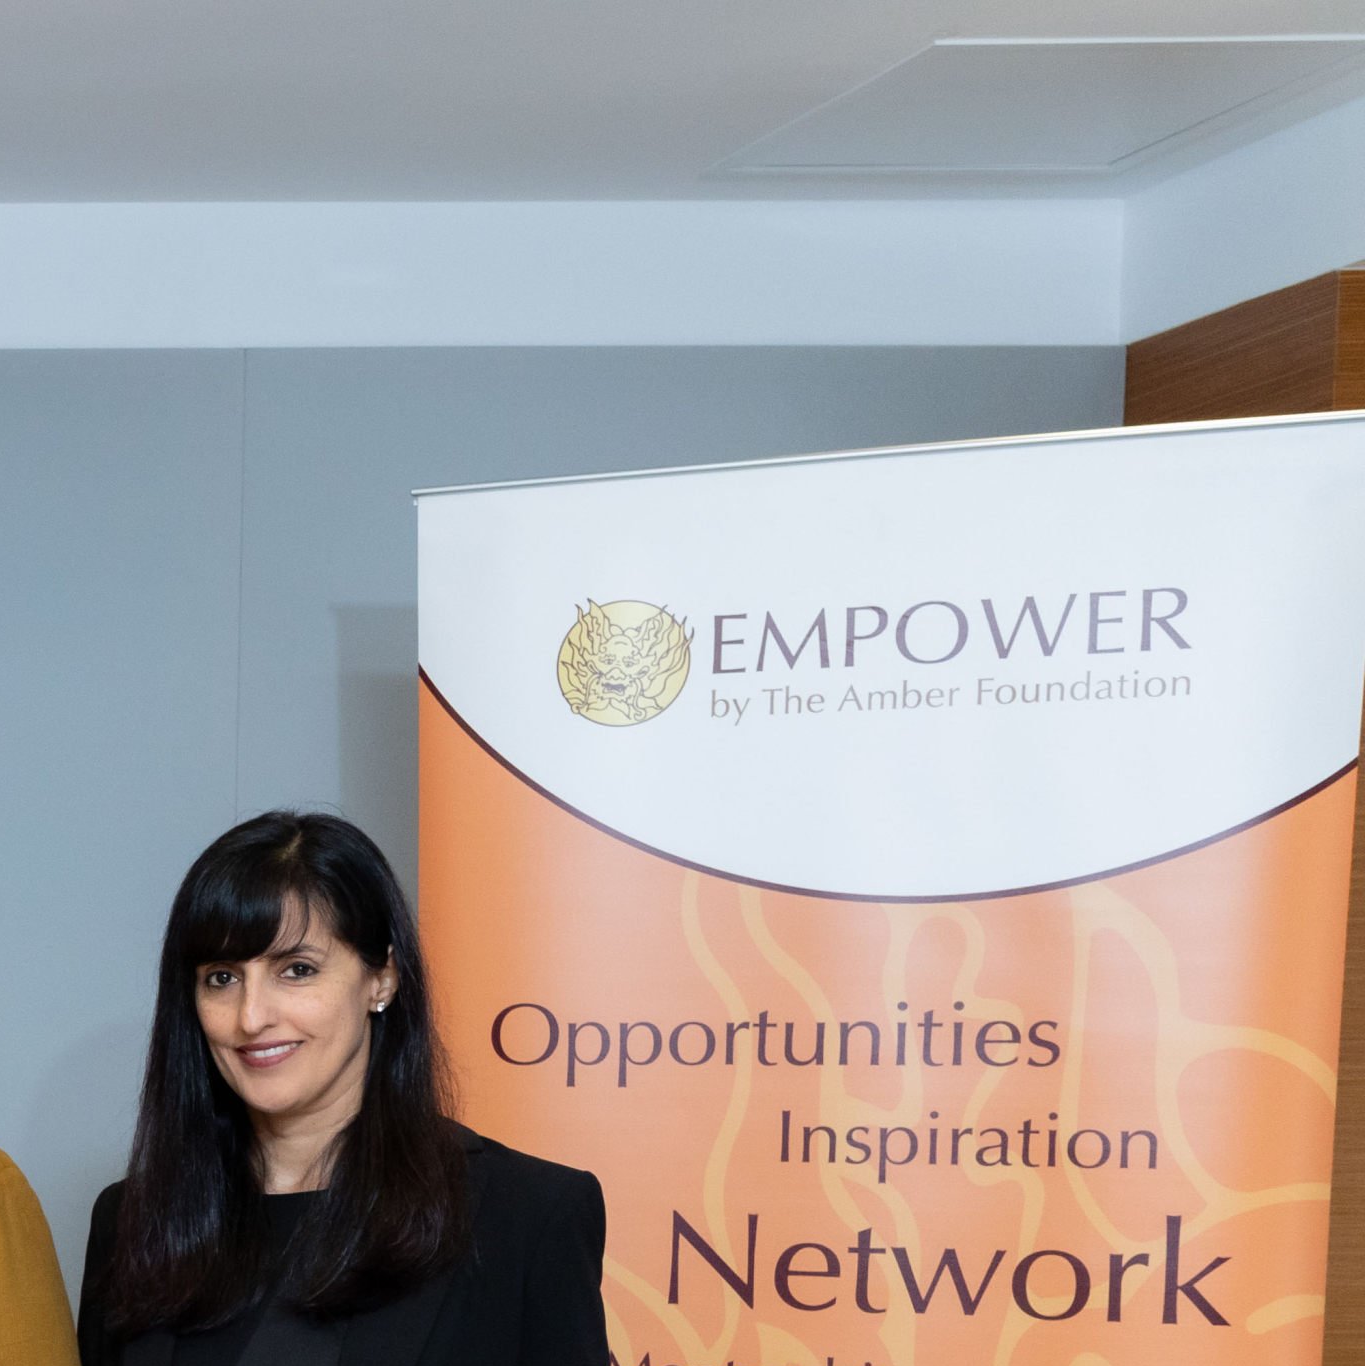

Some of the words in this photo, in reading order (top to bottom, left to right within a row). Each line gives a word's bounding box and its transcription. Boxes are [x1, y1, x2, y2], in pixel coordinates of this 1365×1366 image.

[712, 588, 1191, 674] EMPOWER
[711, 689, 751, 726] by
[762, 686, 825, 716] The
[837, 680, 961, 712] Amber
[976, 670, 1191, 706] Foundation
[490, 1002, 1061, 1087] Opportunities
[780, 1111, 1158, 1184] Inspiration
[668, 1210, 1231, 1326] Network
